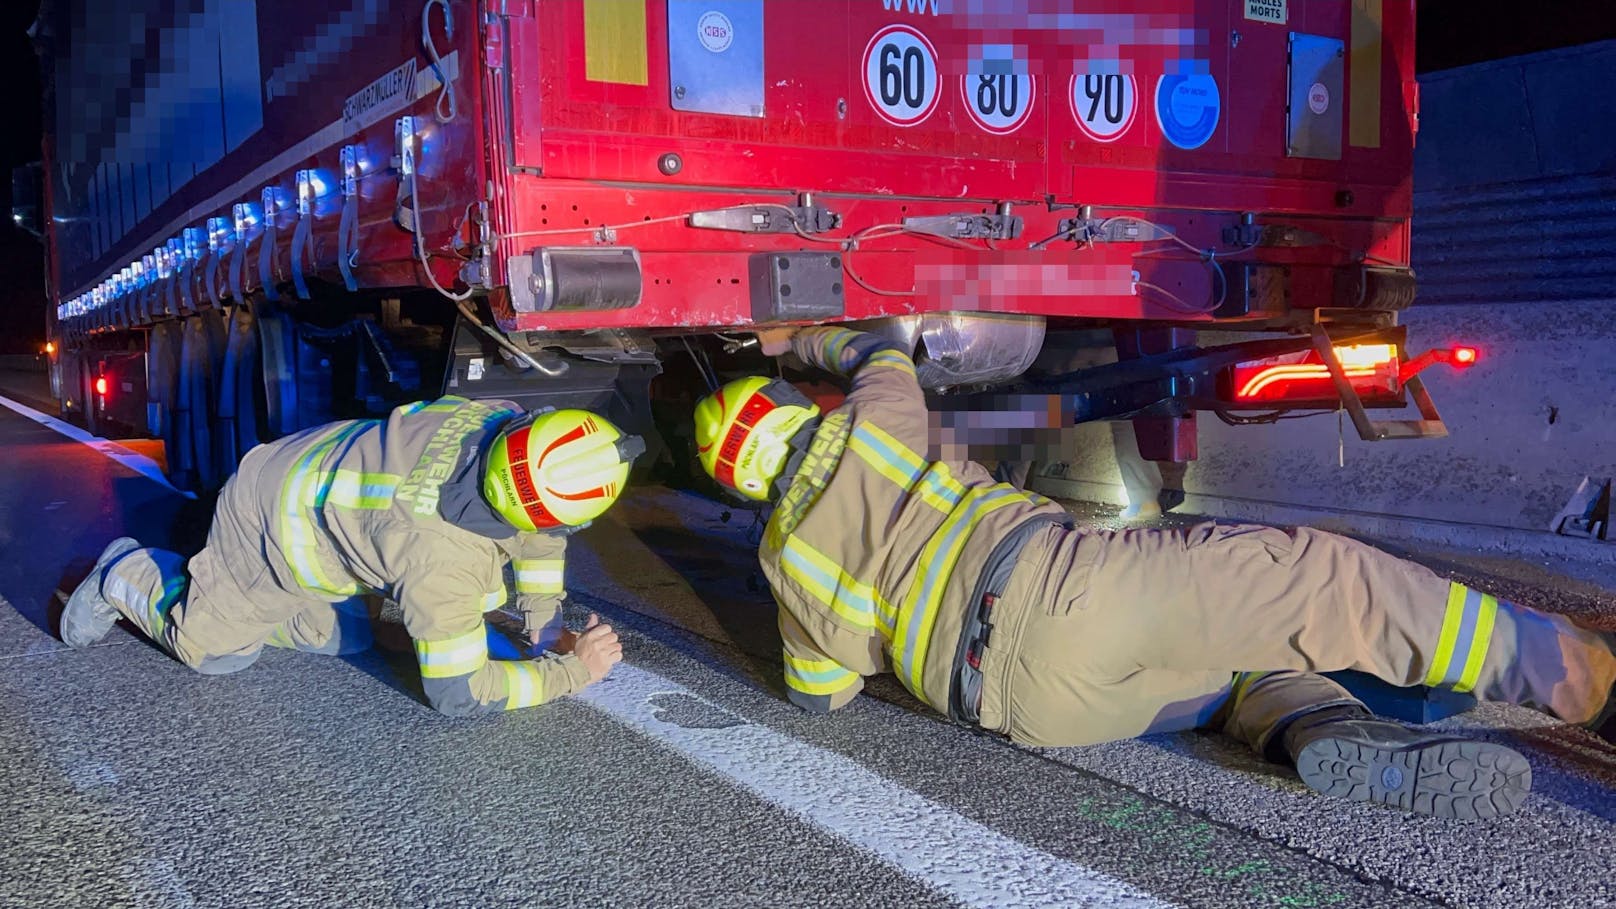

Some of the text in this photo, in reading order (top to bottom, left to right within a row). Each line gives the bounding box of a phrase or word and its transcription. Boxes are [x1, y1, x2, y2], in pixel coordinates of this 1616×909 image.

[1250, 5, 1281, 19] MORTS
[879, 43, 925, 108] 60
[976, 74, 1018, 117] 80
[1084, 74, 1124, 124] 90
[512, 447, 545, 517] FEUERWEHR
